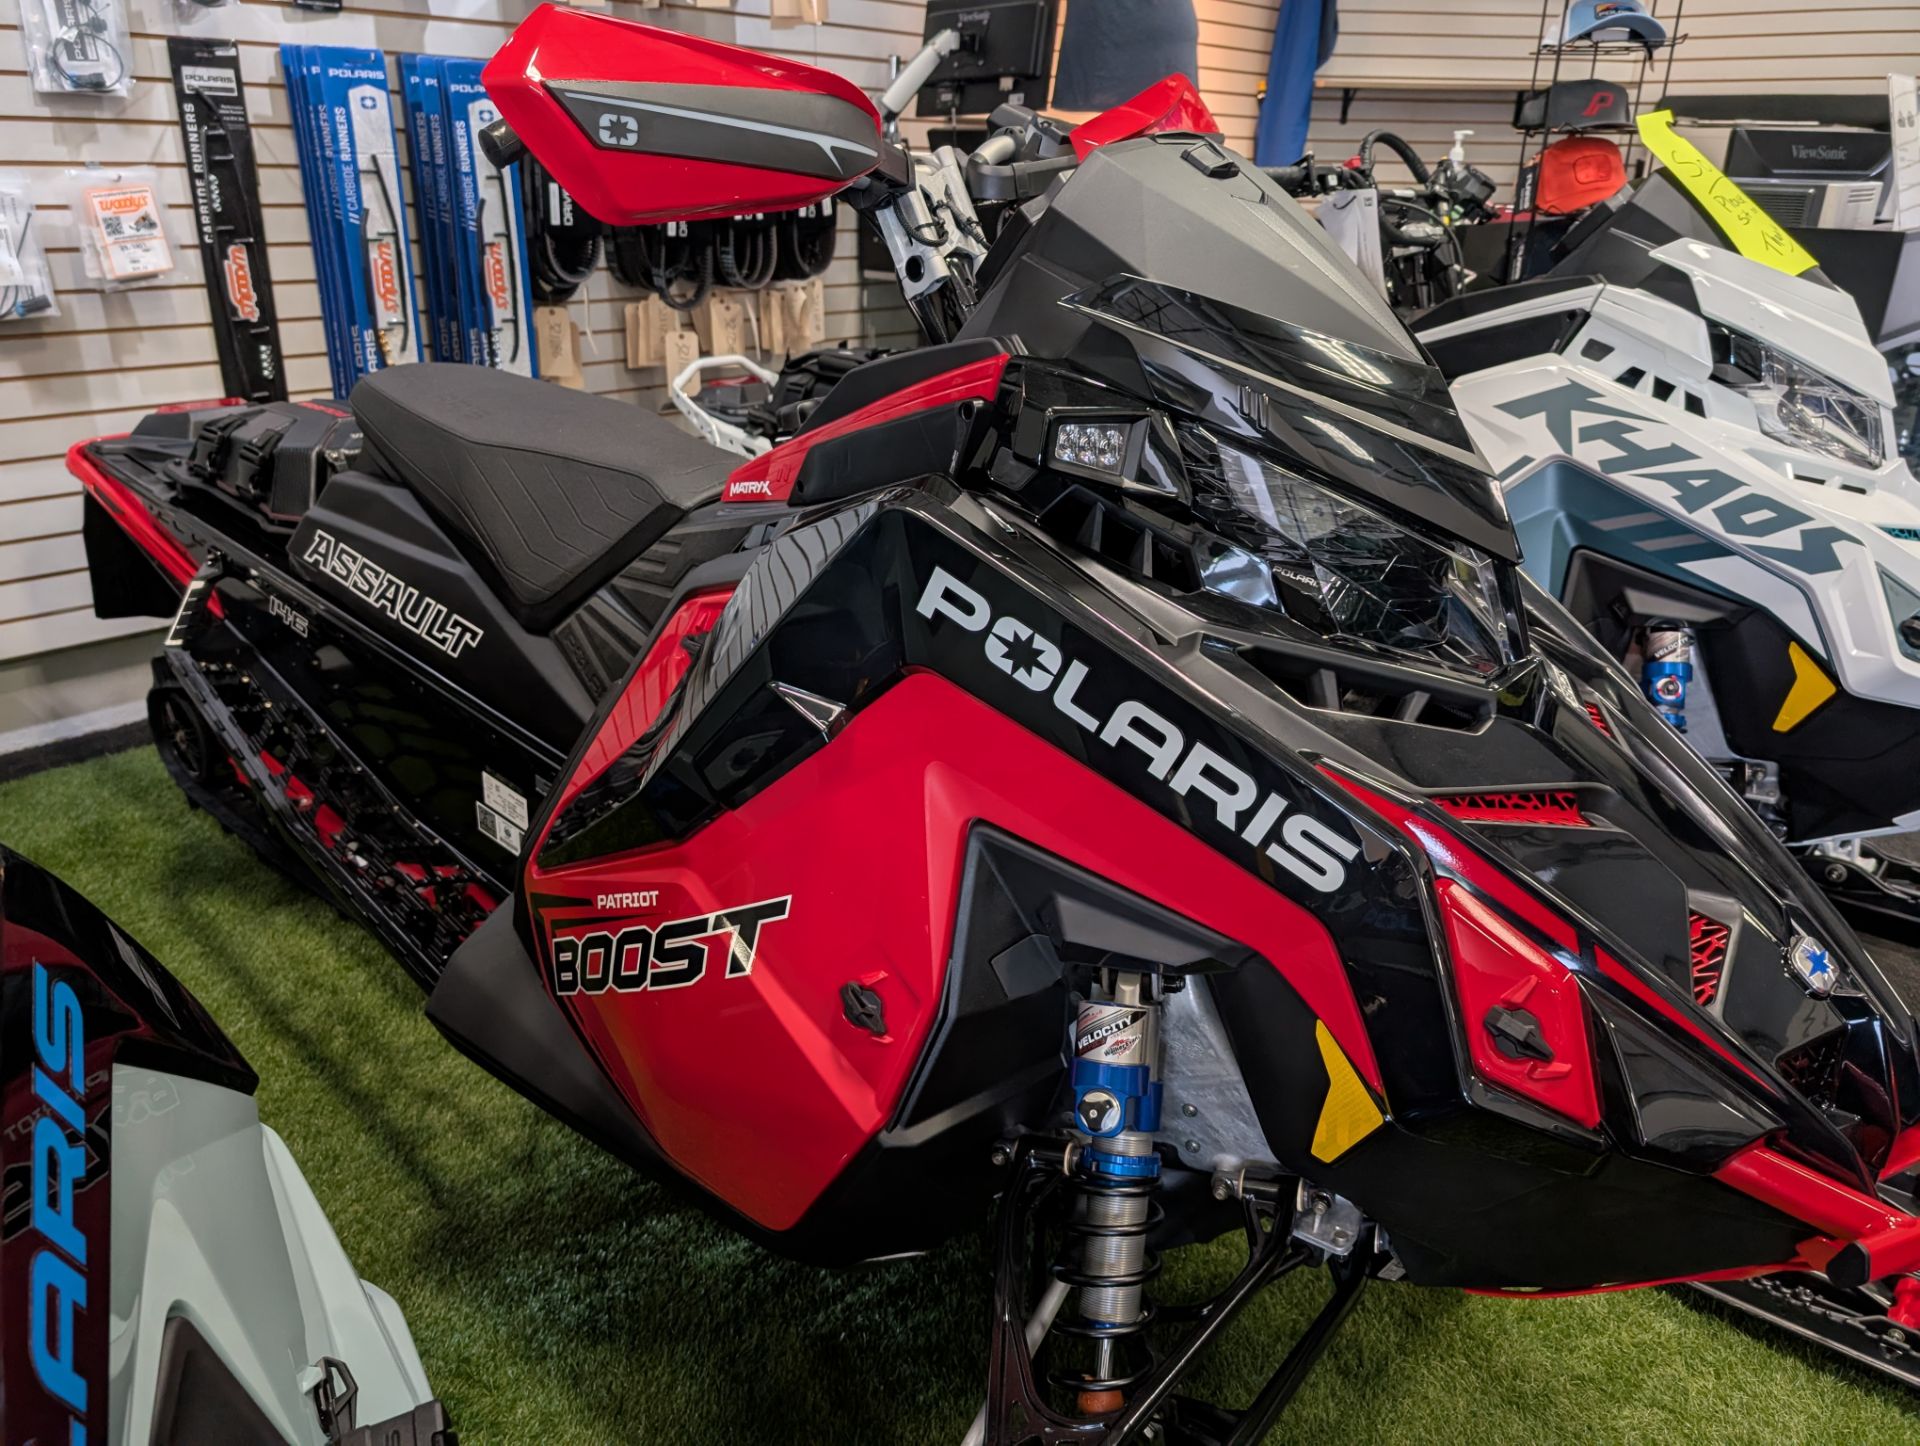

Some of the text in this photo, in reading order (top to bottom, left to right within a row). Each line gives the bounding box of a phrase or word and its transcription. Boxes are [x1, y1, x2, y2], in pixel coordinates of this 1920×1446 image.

[64, 0, 85, 60] POARI
[184, 74, 234, 84] POLARIS
[328, 68, 385, 80] POLARIS
[450, 84, 487, 93] POLA
[182, 103, 203, 173] RUNNERS
[334, 106, 359, 211] CARBIDE RUNNERS
[431, 114, 445, 165] RUNNERS
[455, 120, 472, 173] RUNNERS
[1791, 144, 1849, 160] ViewSonic
[462, 175, 478, 219] CARBIDE
[363, 328, 379, 373] ARIS
[729, 480, 773, 497] MATRYX
[1493, 377, 1867, 576] KHAOS
[303, 529, 484, 659] ASSAULT
[268, 595, 309, 639] 146
[1654, 635, 1689, 659] VELOCITY
[915, 565, 1360, 893] POLARIS
[597, 890, 660, 910] PATRIOT
[551, 894, 793, 997] BOOST
[1078, 1014, 1132, 1050] VELOCITY
[29, 957, 88, 1446] ARIS
